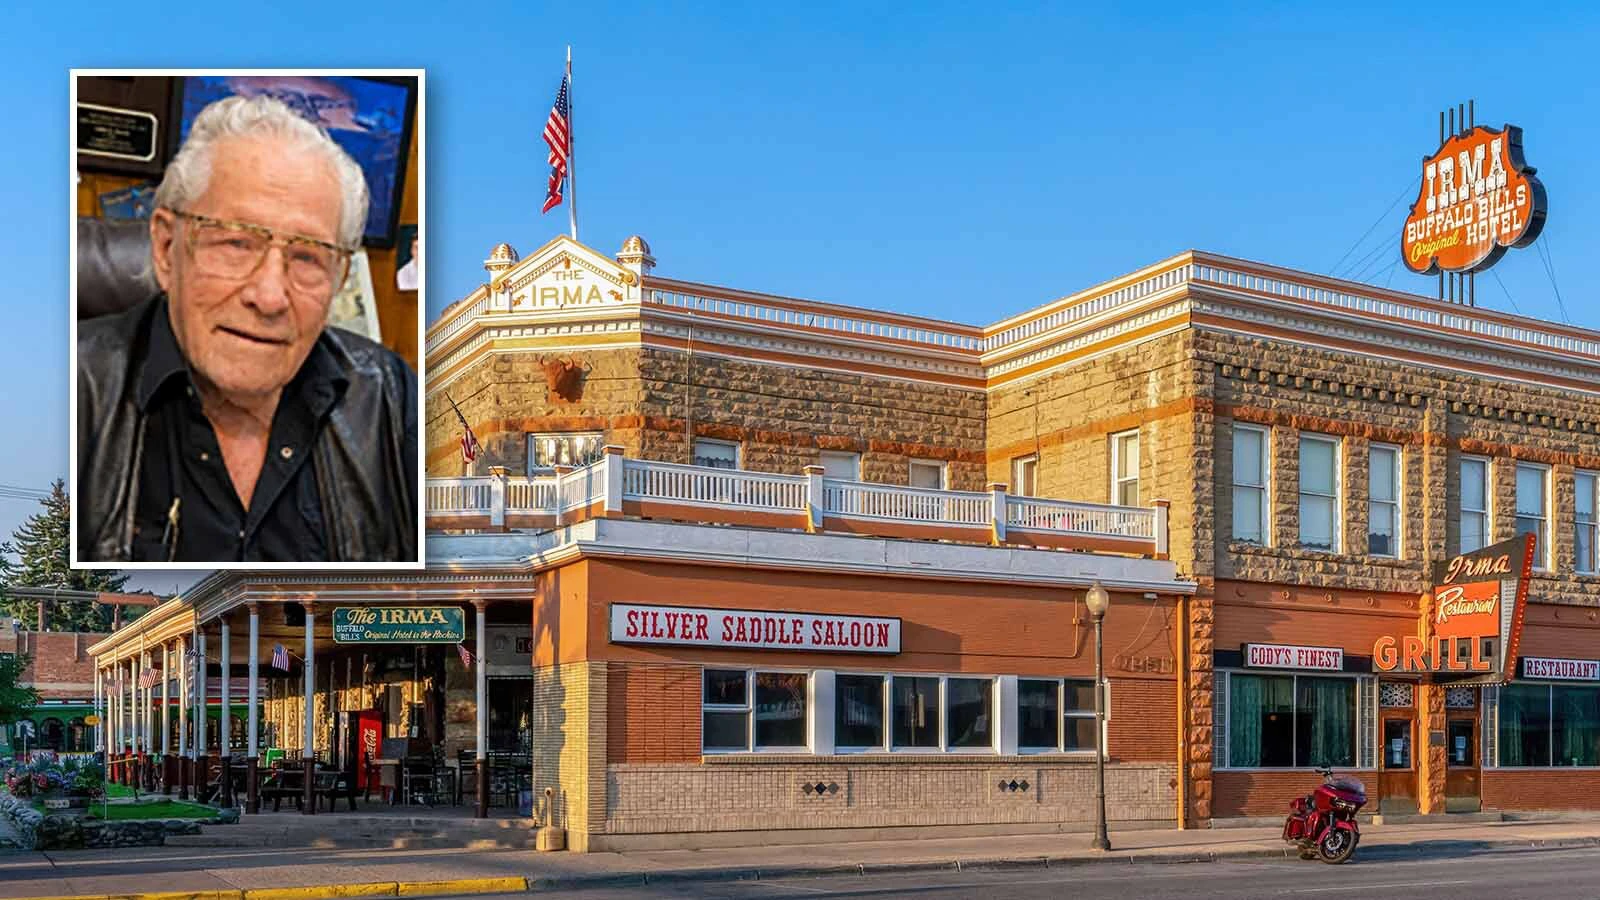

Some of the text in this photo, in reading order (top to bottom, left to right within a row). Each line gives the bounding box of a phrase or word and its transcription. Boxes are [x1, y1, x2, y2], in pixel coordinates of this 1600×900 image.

[1425, 137, 1507, 213] IRMA
[1407, 203, 1473, 244] BUFFALO
[1466, 210, 1522, 246] HOTEL
[1411, 229, 1460, 263] Original
[552, 269, 585, 281] THE
[531, 284, 604, 307] IRMA
[1443, 553, 1512, 584] Irma
[347, 608, 449, 625] The IRMA
[1436, 586, 1500, 624] Restaurant
[336, 624, 365, 633] BUFFALO
[364, 630, 390, 640] Original
[626, 610, 890, 648] SILVER SADDLE SALOON
[1251, 647, 1340, 669] CODY'S FINEST
[1373, 635, 1490, 671] GRILL
[1526, 660, 1599, 678] RESTAURANT
